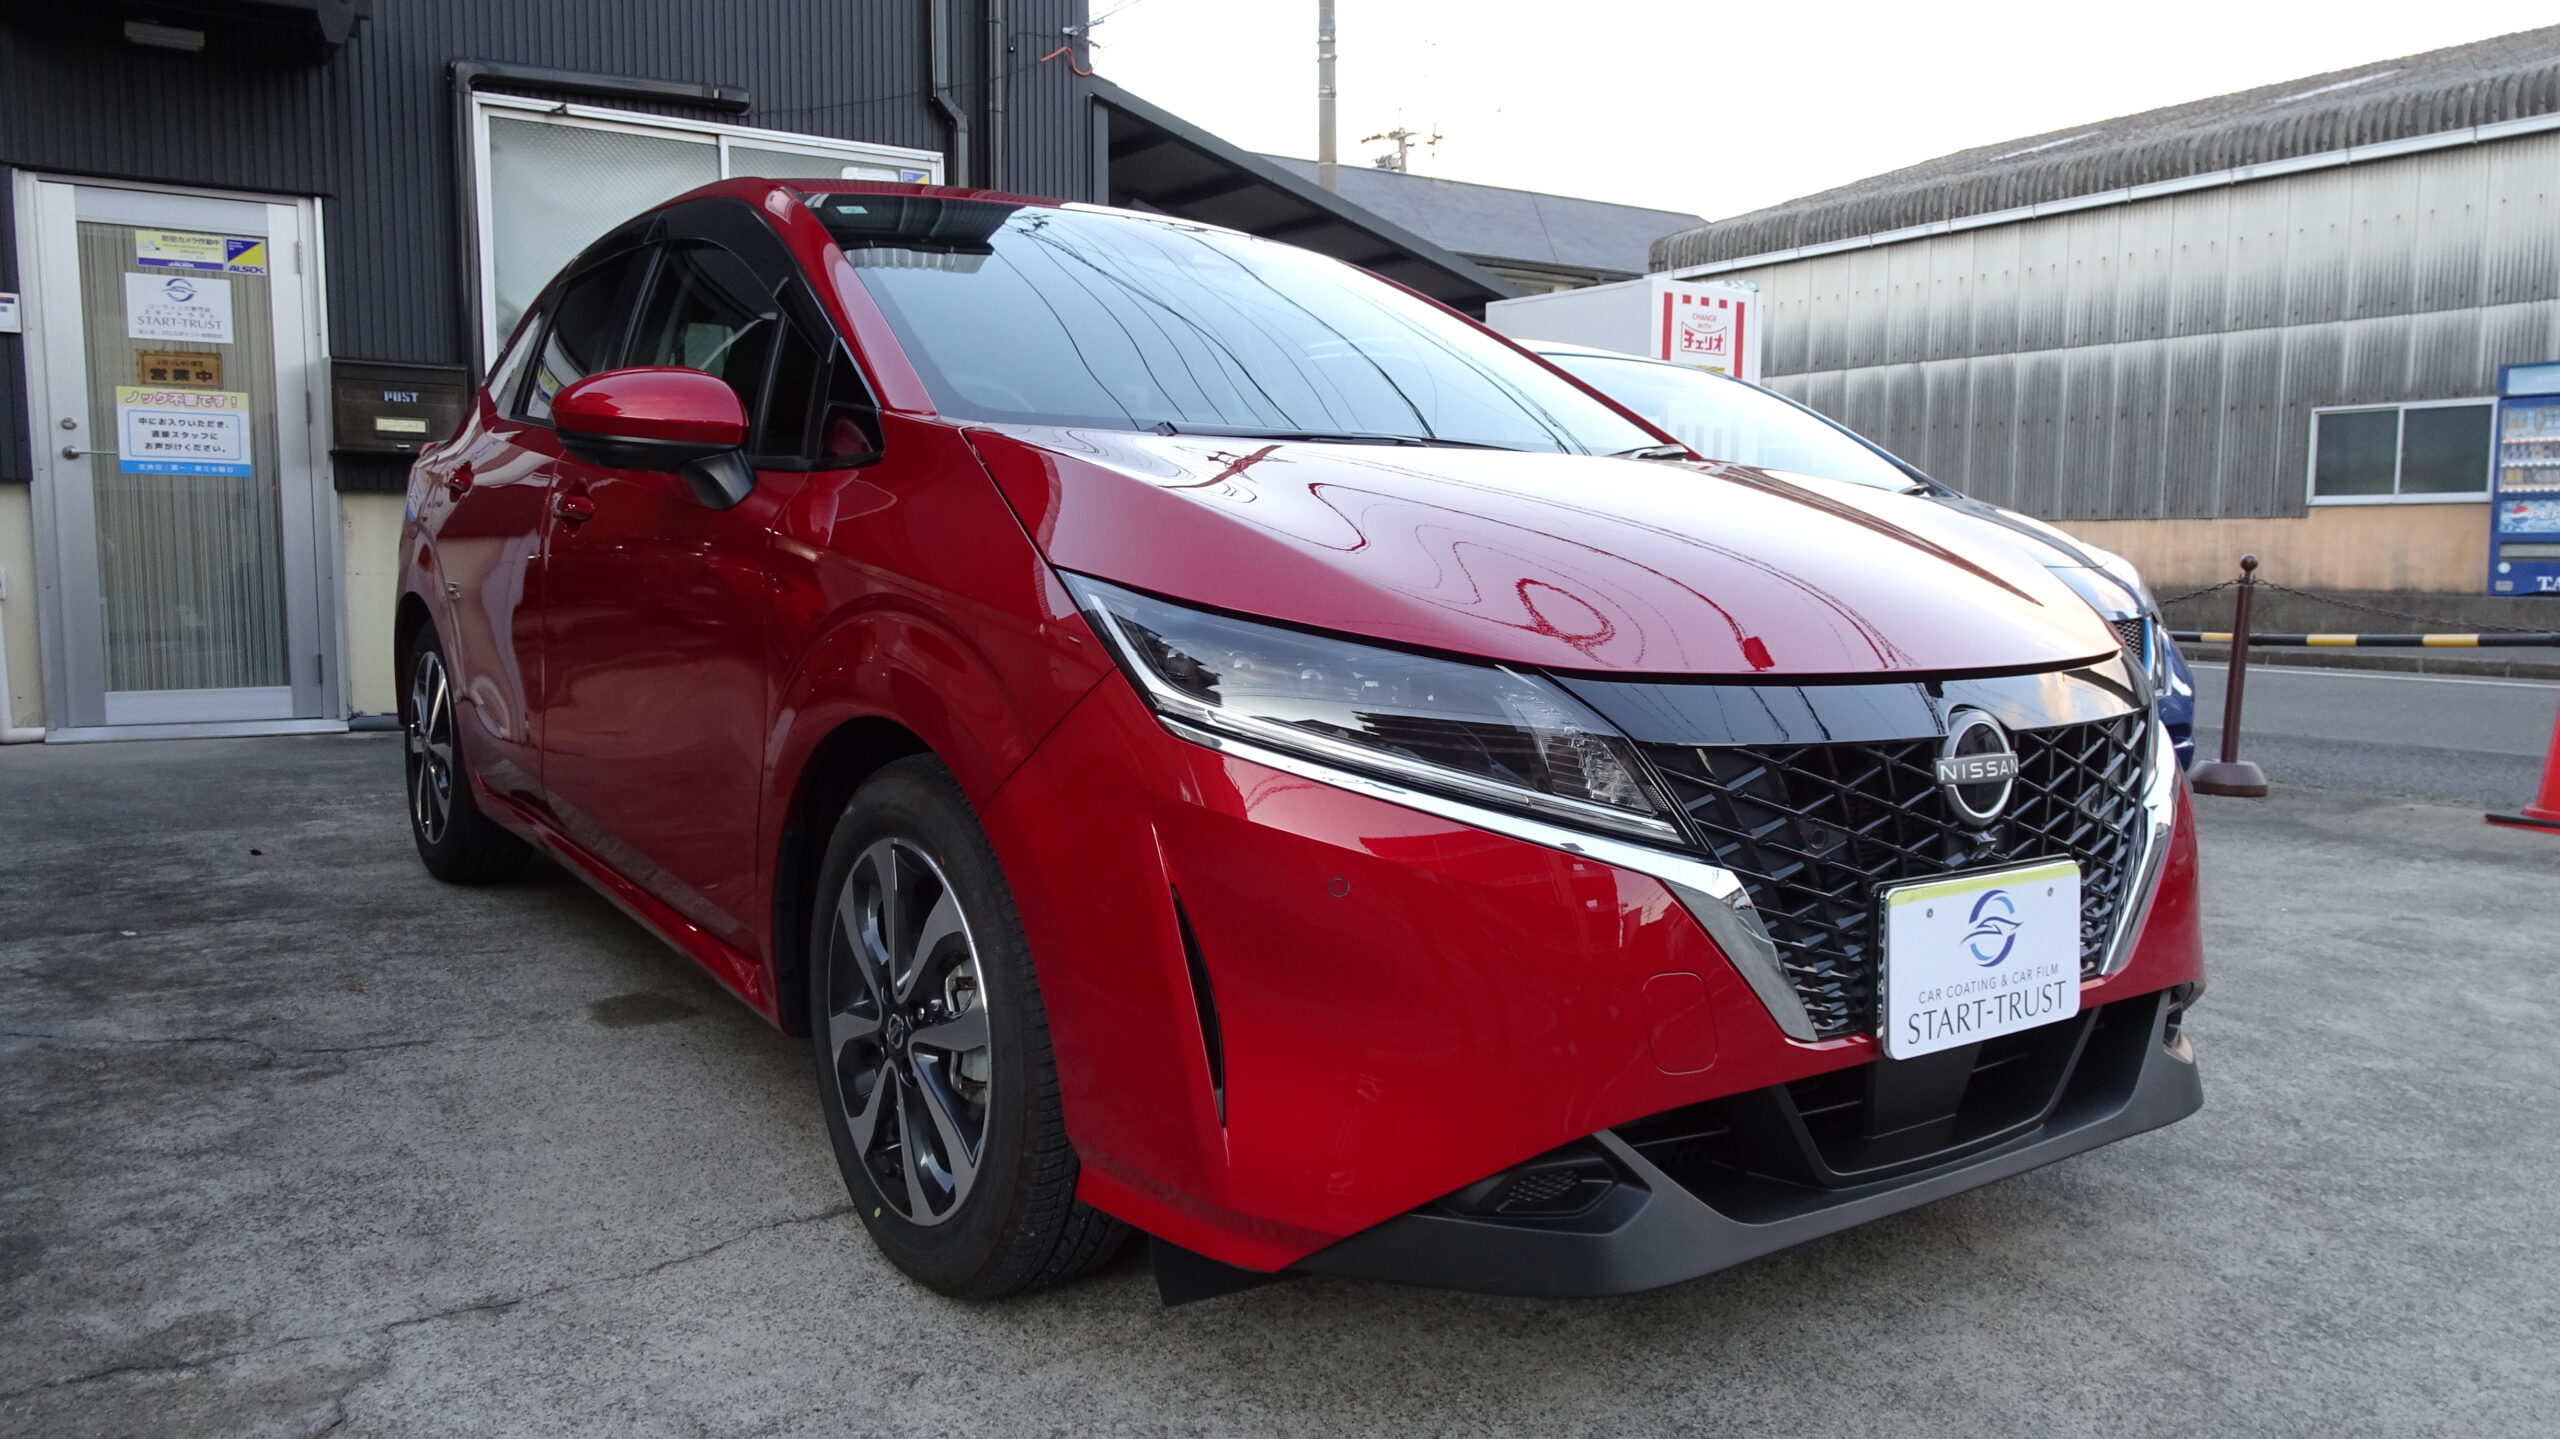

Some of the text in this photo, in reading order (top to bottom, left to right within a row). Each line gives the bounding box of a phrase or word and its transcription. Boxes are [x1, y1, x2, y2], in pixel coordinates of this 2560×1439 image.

[228, 265, 264, 274] ALSOK
[137, 315, 222, 330] START-TRUST
[1684, 329, 1723, 351] チェリオ
[150, 367, 213, 382] 営業中
[384, 390, 419, 403] POST
[1940, 758, 2018, 781] NISSAN
[1918, 963, 2059, 1004] CAR COATING & CAR FILM
[1907, 980, 2067, 1045] START-TRUST
